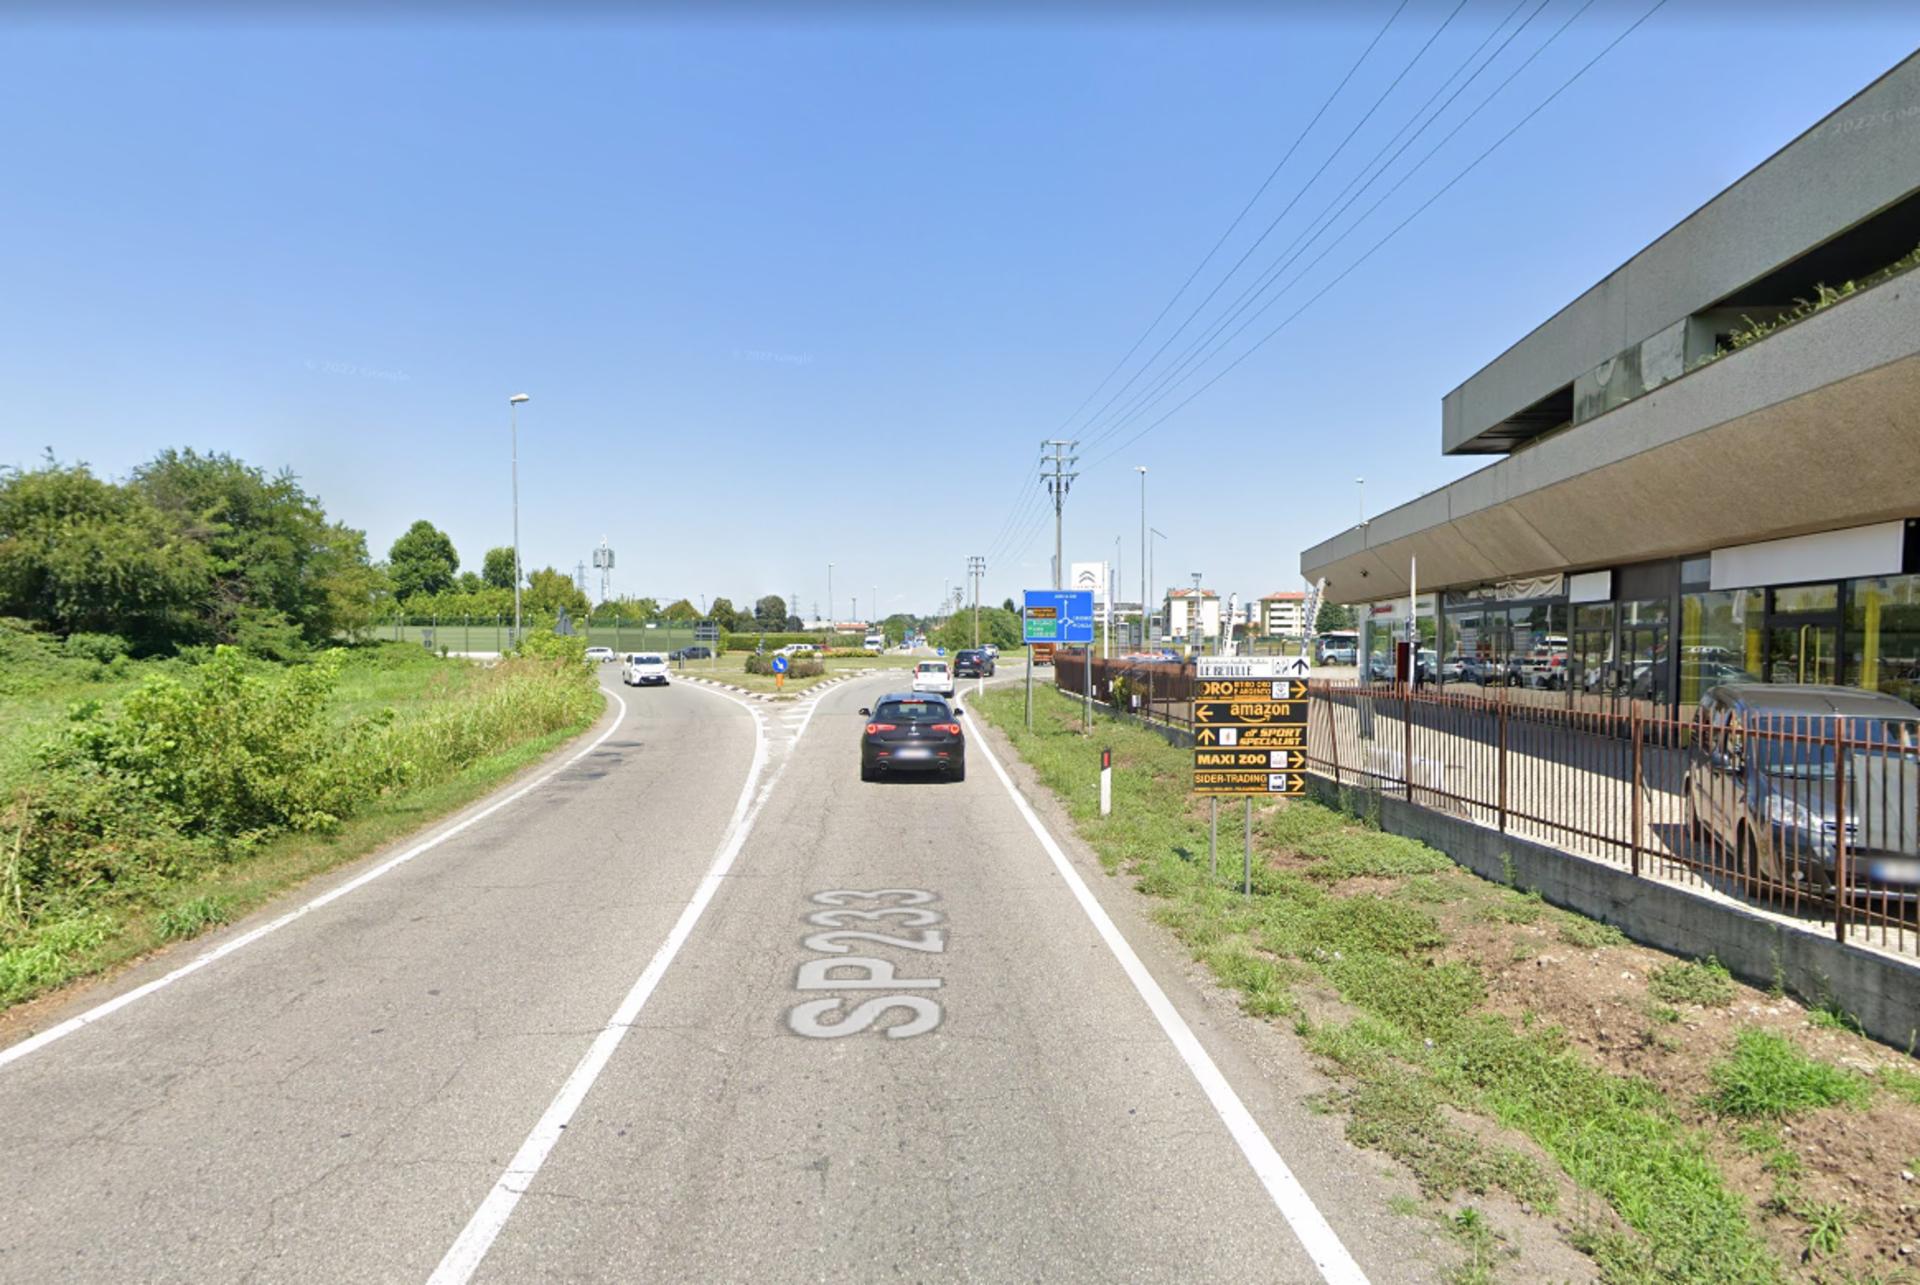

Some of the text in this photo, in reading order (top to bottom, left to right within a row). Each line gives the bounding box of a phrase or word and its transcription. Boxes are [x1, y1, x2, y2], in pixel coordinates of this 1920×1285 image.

[1231, 704, 1290, 716] amazon
[1260, 728, 1302, 737] SPORT
[1239, 737, 1302, 746] SPECIALIST
[1197, 754, 1266, 765] MAXI ZOO
[1195, 774, 1267, 784] SIDER-TRADING
